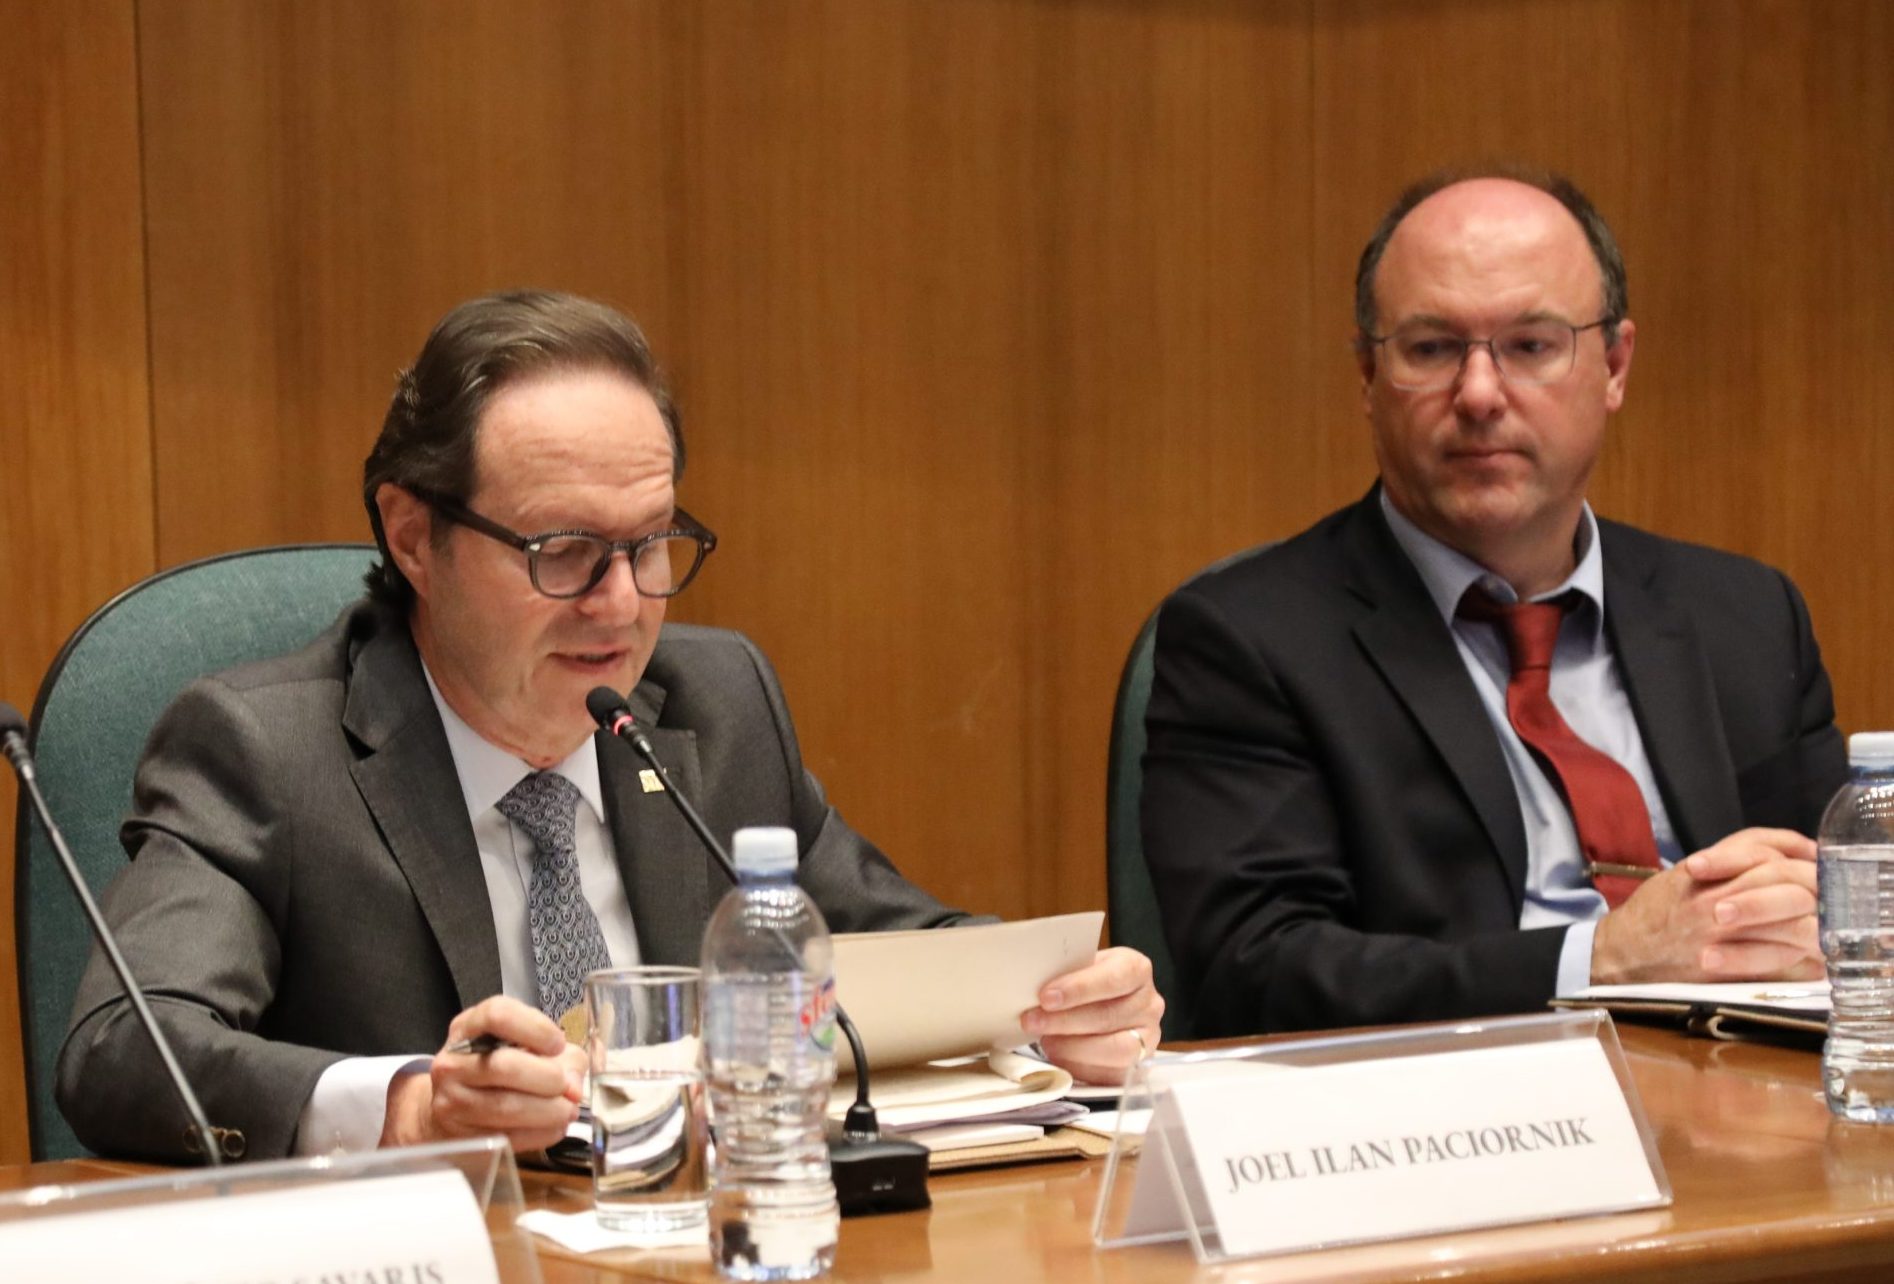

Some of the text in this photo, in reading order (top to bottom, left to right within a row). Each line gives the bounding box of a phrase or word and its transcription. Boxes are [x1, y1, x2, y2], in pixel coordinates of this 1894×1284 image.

[1225, 1118, 1595, 1194] JOEL ILAN PACIORNIK
[291, 1261, 443, 1284] ARIS
